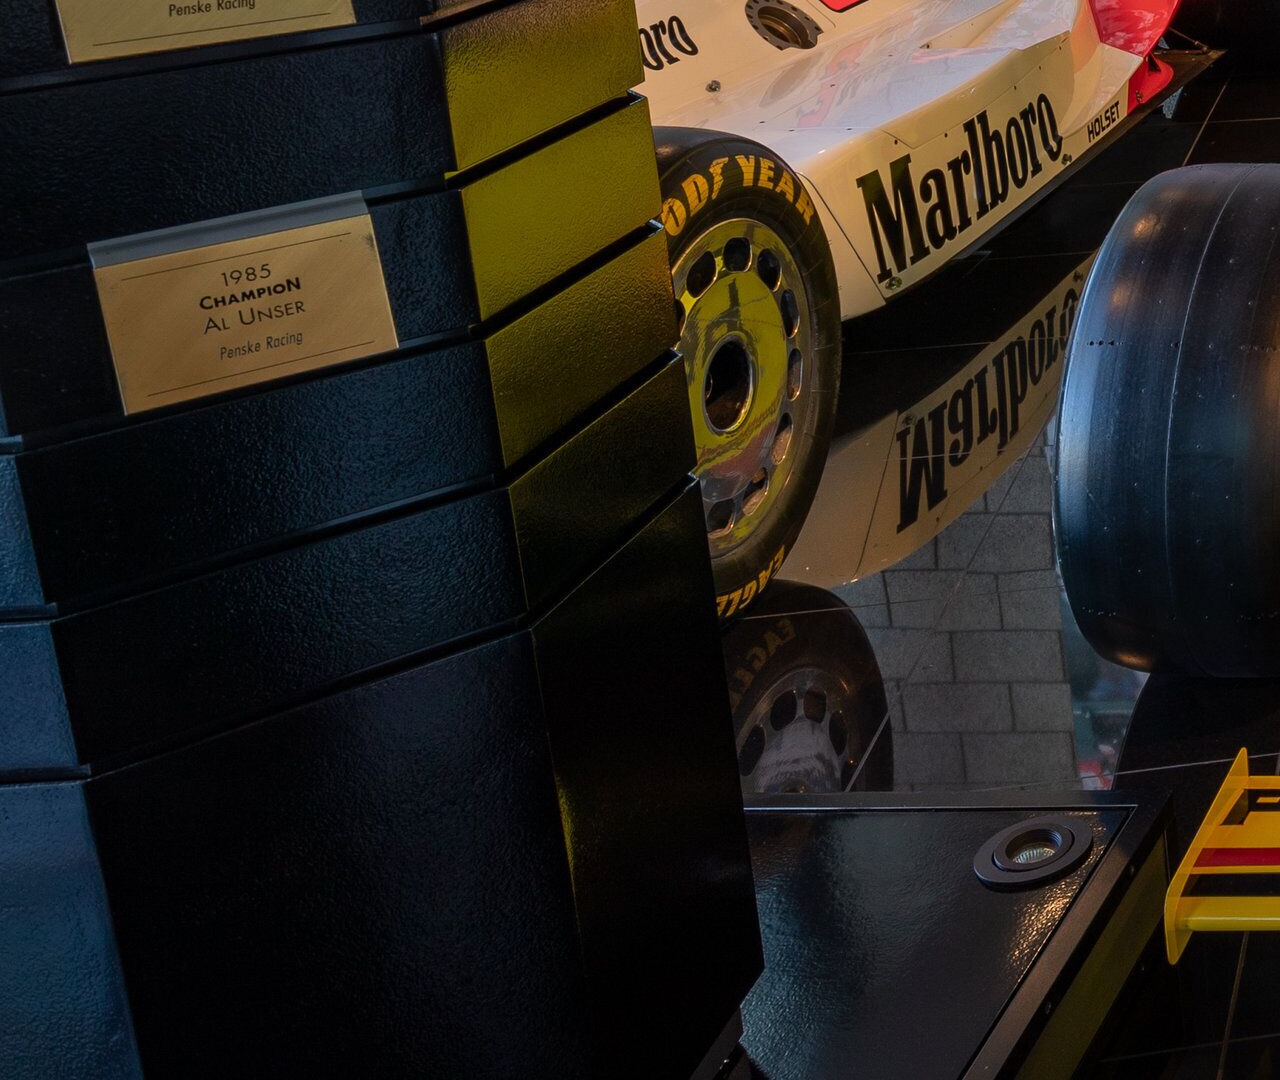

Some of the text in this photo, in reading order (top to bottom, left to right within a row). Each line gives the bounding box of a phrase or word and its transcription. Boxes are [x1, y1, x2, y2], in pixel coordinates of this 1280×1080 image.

[168, 0, 213, 18] Penske
[1087, 99, 1122, 144] HOLSET
[856, 91, 1064, 282] Marlboro
[221, 263, 272, 287] 1985
[199, 276, 302, 311] CHAMPION
[238, 300, 306, 326] UNSER
[219, 331, 304, 361] Penske Racing
